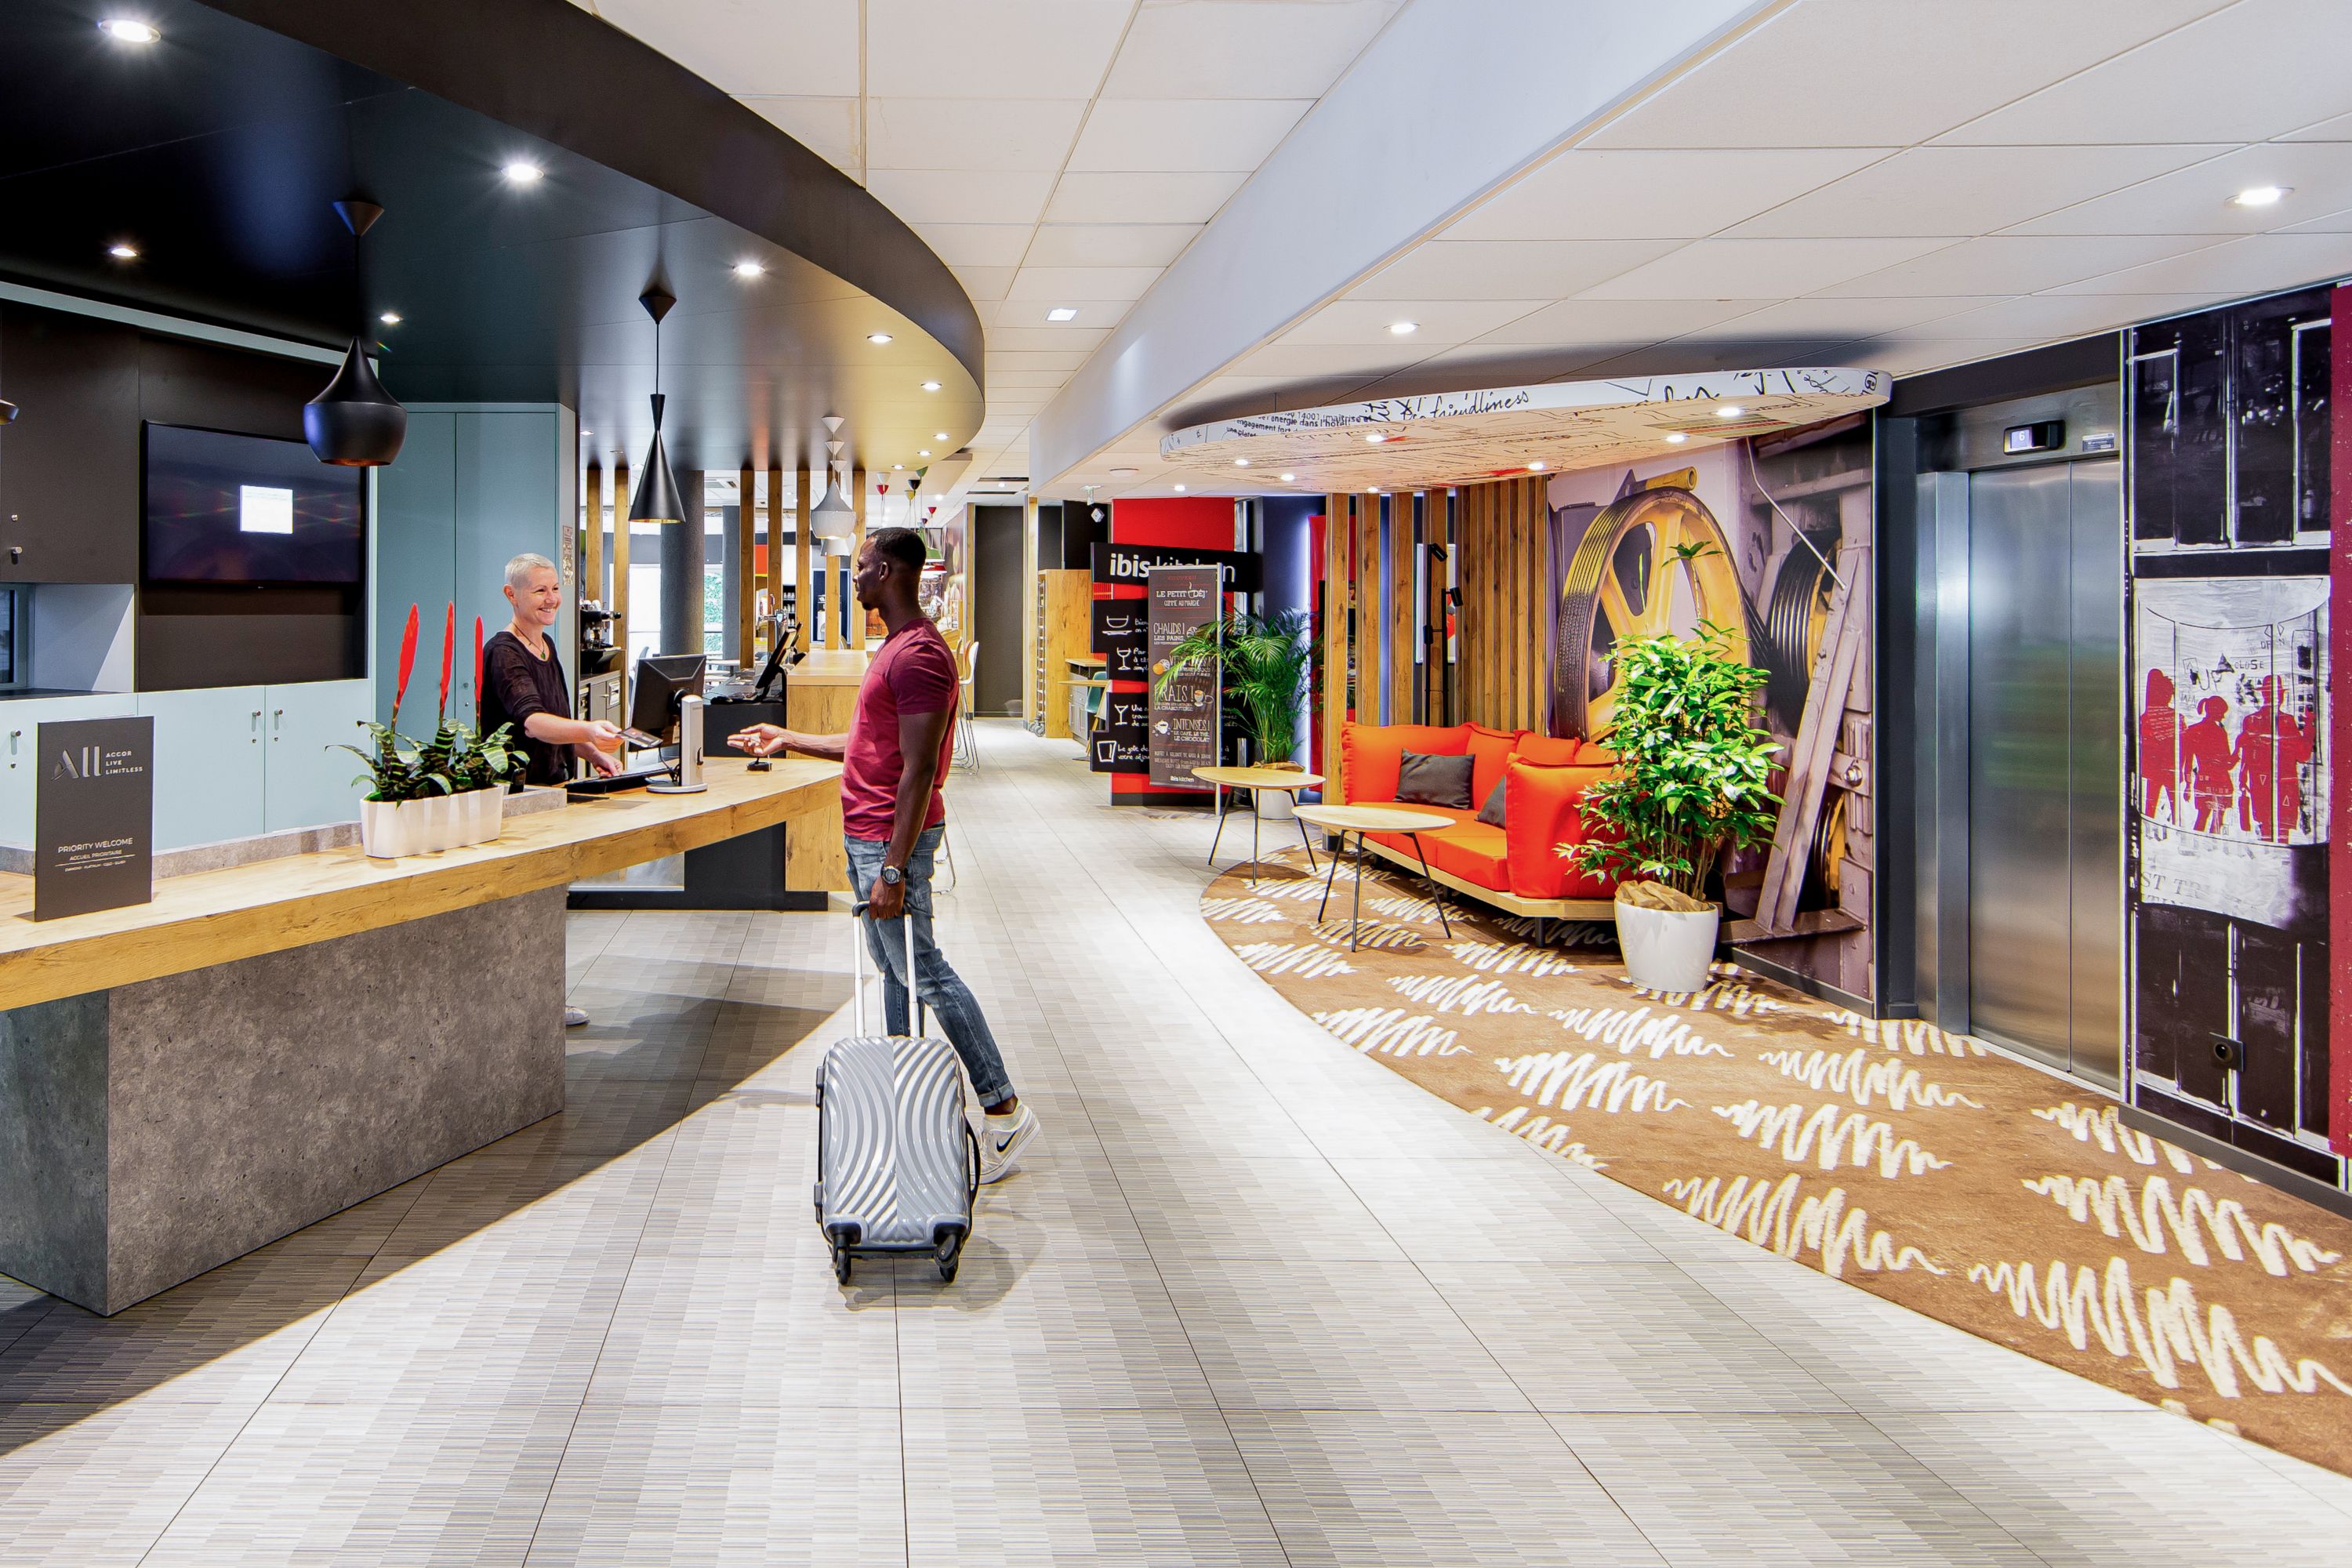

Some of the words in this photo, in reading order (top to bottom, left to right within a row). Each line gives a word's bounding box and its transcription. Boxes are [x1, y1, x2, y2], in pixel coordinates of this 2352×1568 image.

[1300, 419, 1318, 427] dans
[1109, 553, 1150, 578] ibis
[105, 766, 143, 775] LIMITLESS
[57, 843, 94, 853] PRIORITY
[94, 837, 133, 848] WELCOME
